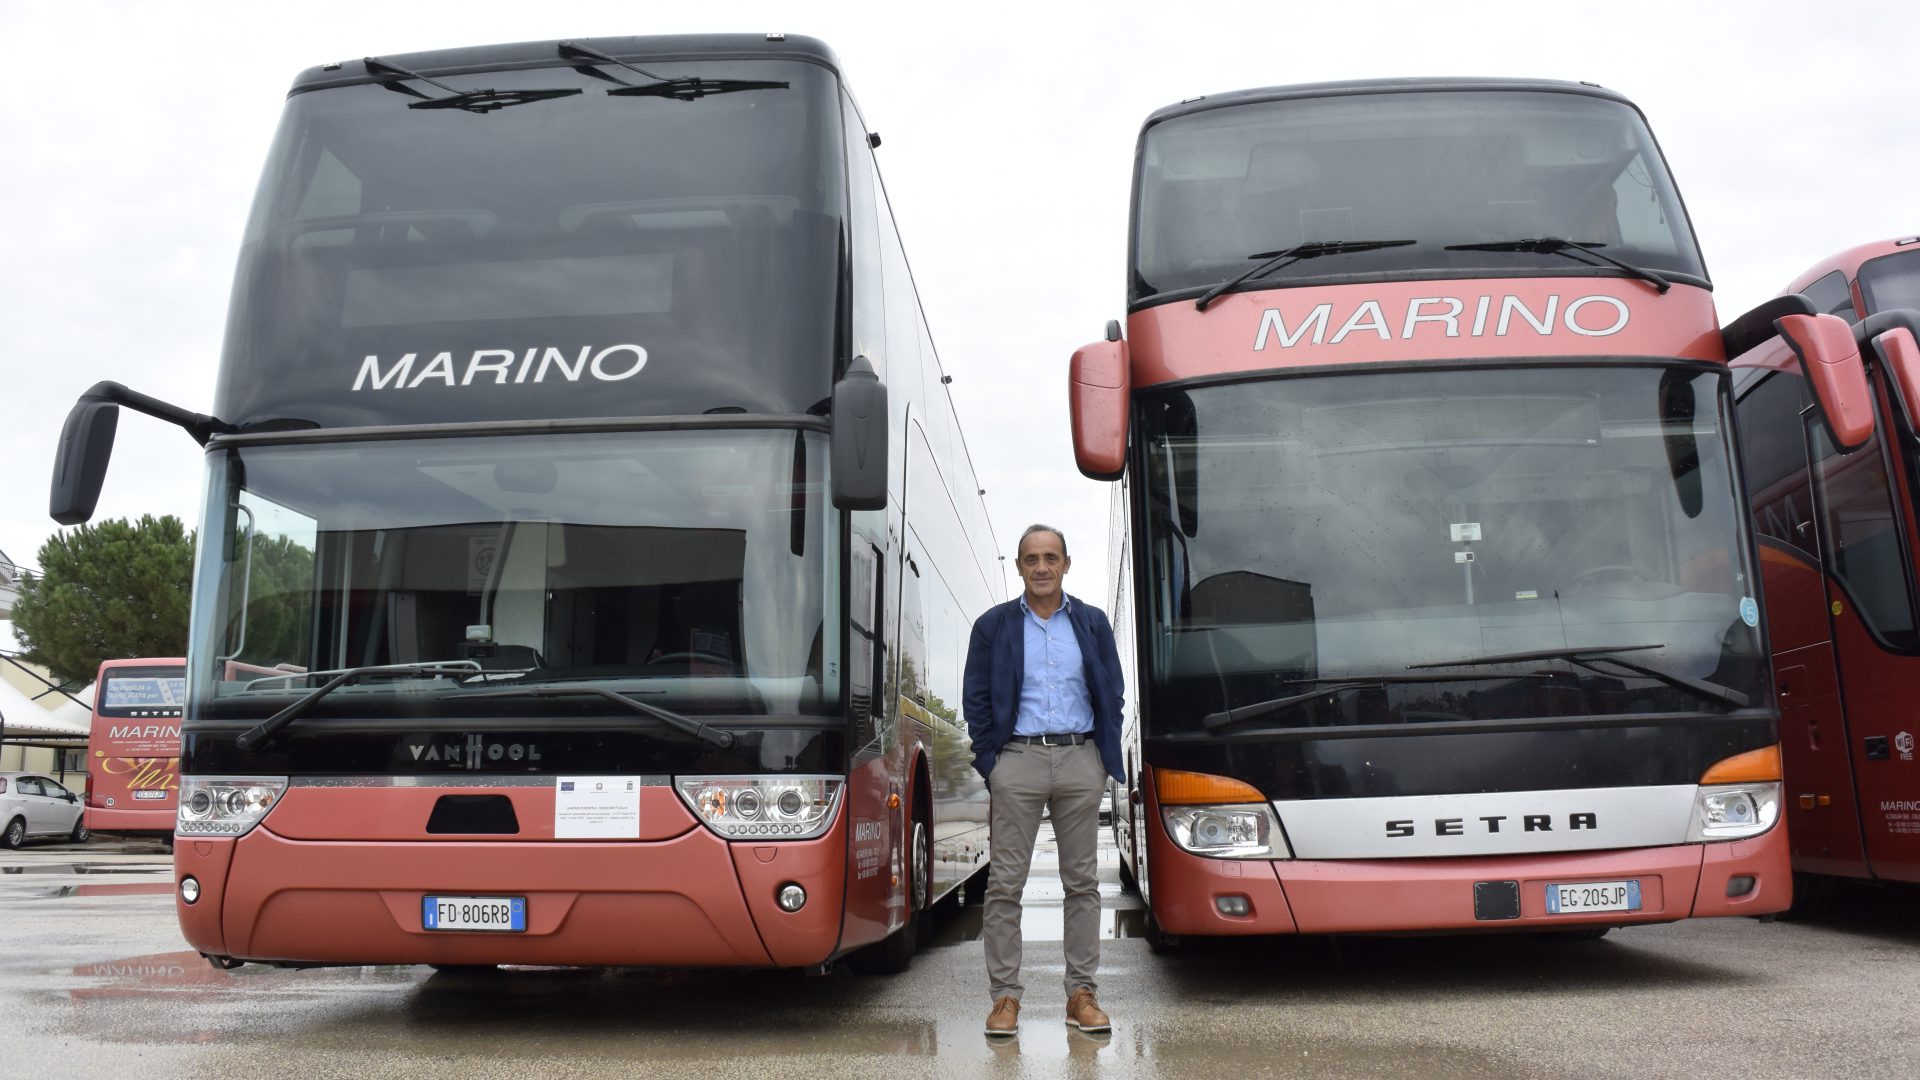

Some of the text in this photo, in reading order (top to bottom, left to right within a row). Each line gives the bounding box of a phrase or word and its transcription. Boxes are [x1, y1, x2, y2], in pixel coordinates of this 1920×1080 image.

[1254, 295, 1631, 352] MARINO
[351, 344, 649, 392] MARINO
[109, 726, 182, 738] MARIN
[855, 822, 881, 841] MARINO
[1386, 812, 1597, 837] SETRA
[1560, 887, 1626, 907] EG 205JP
[438, 904, 510, 923] FD 806RB
